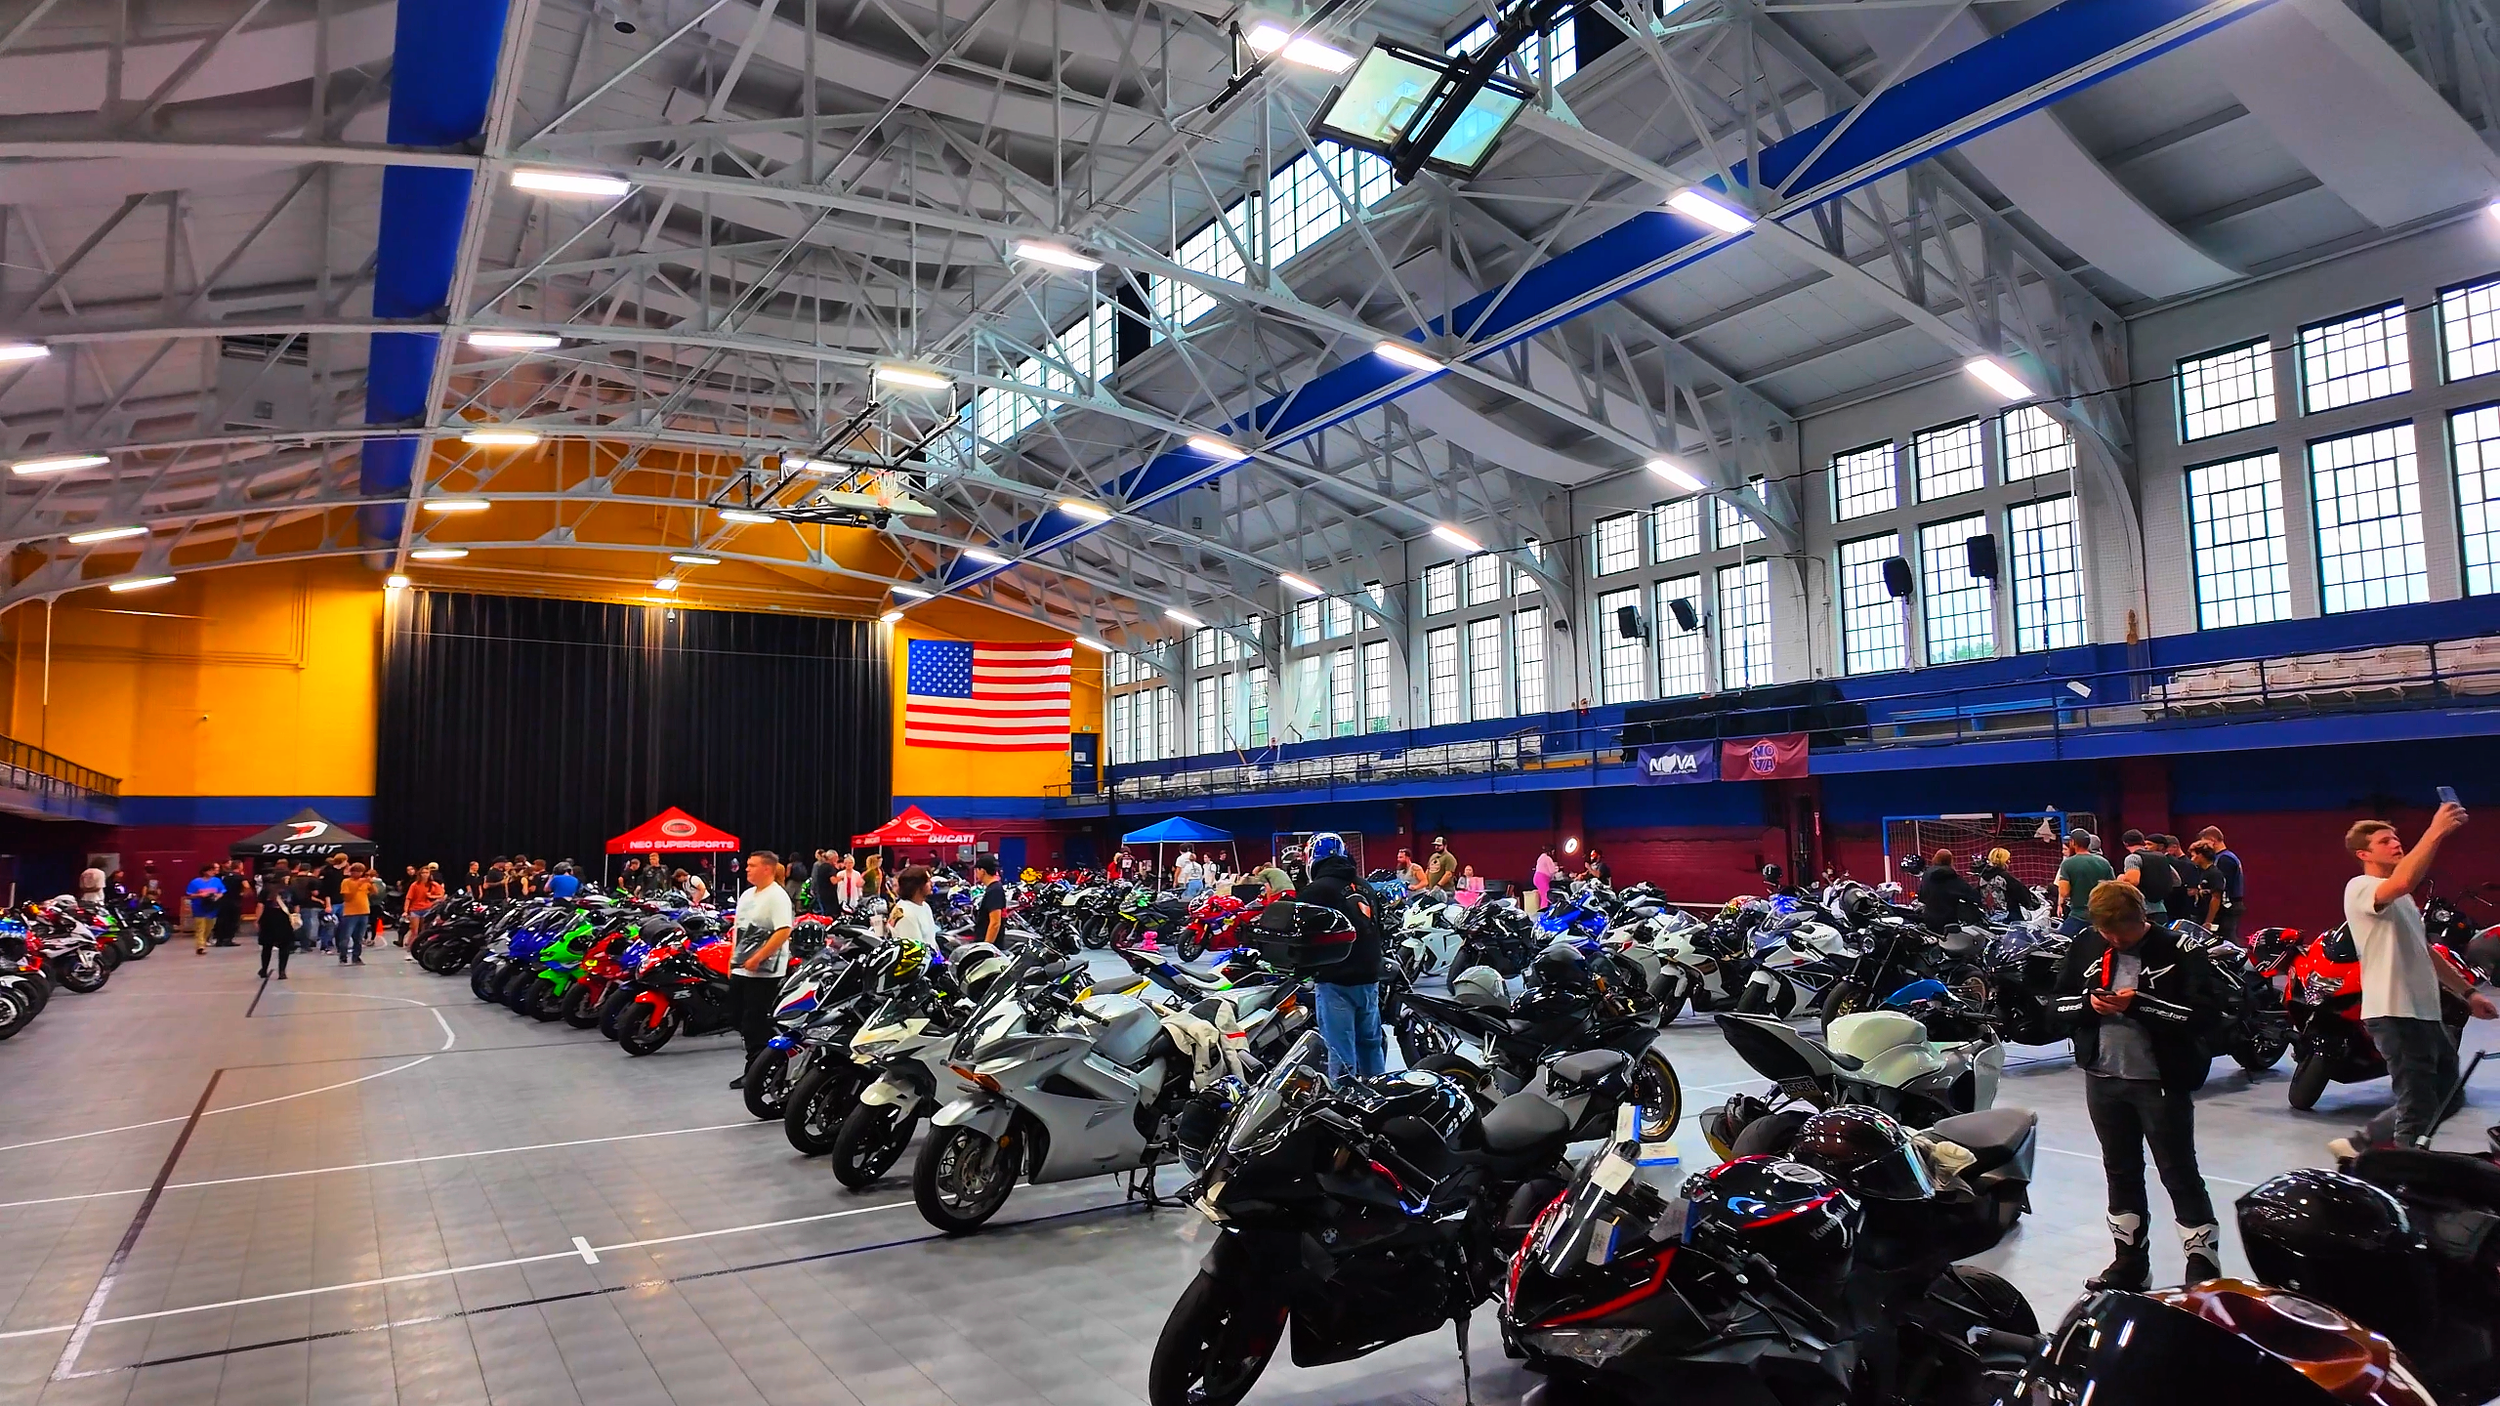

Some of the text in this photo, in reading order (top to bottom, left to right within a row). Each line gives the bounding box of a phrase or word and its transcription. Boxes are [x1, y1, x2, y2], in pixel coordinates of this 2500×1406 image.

[927, 834, 975, 843] DUCATI
[629, 840, 735, 849] NEO SUPERSPORTS
